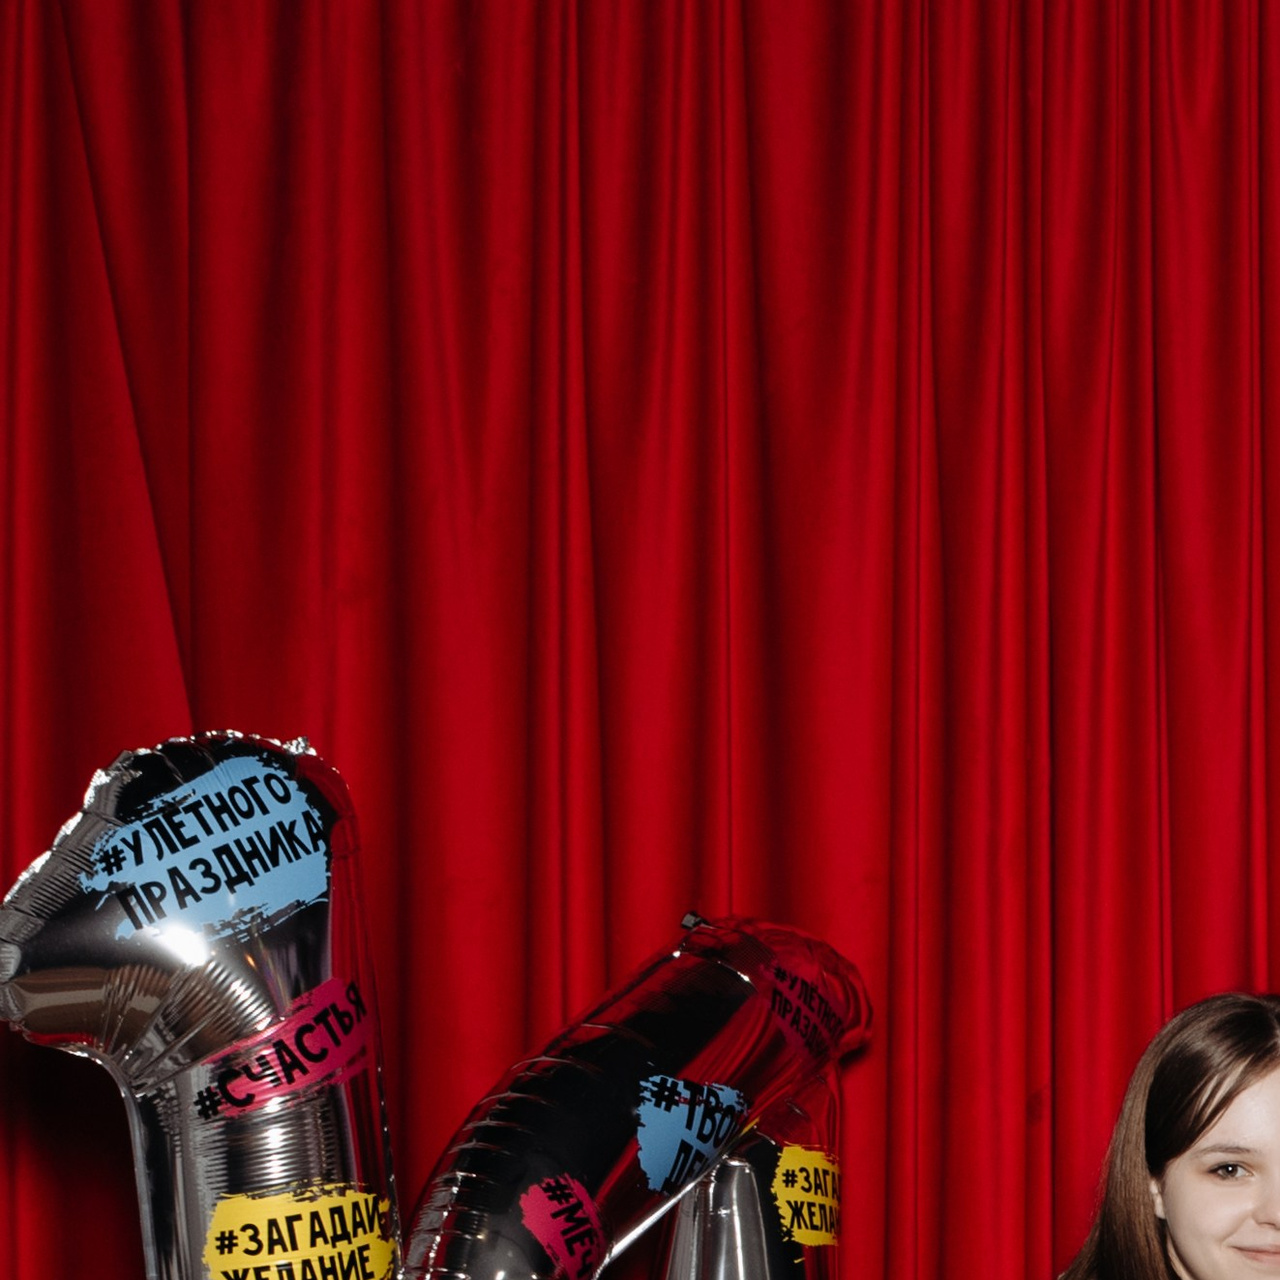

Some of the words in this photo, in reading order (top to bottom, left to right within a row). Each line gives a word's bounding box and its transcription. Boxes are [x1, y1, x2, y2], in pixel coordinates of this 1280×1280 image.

[117, 811, 326, 931] ПРАЗДНИКА
[194, 981, 368, 1121] #СЧАСТЬЯ
[650, 1076, 738, 1149] #ТВО
